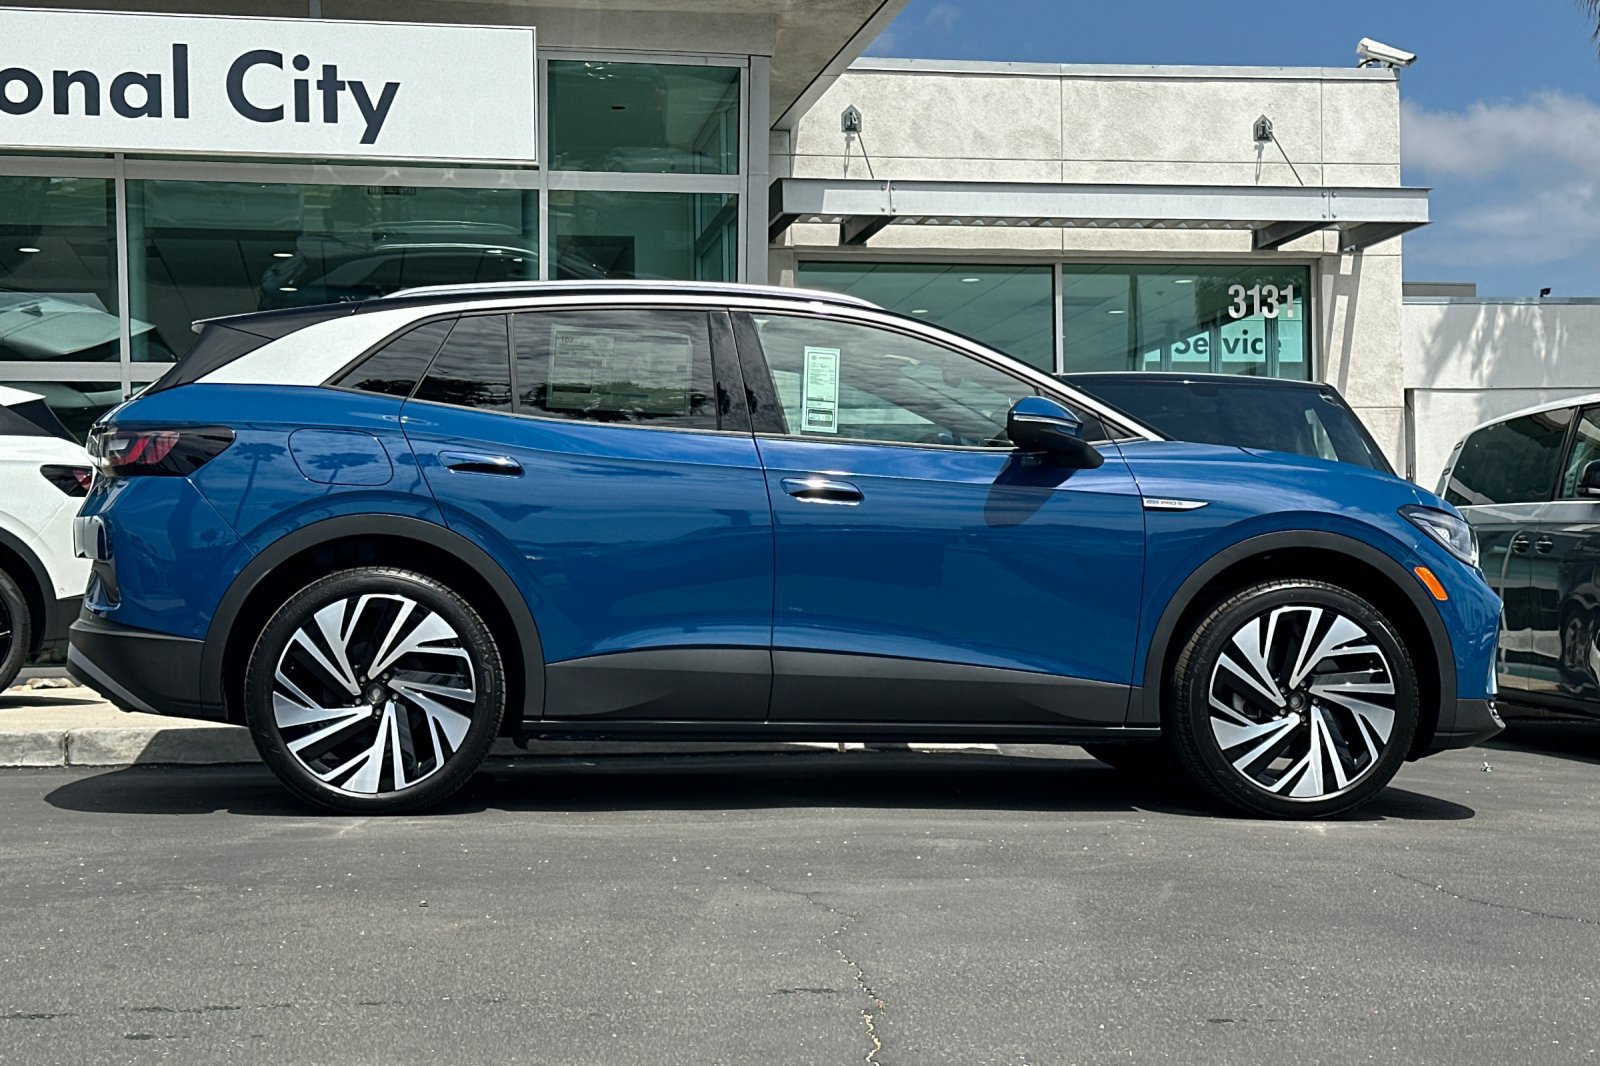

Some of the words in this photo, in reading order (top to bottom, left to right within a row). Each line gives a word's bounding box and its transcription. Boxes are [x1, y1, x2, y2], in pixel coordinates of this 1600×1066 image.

[0, 43, 189, 119] onal
[226, 49, 401, 144] City
[1228, 284, 1294, 318] 3131
[1174, 328, 1282, 355] Sevic
